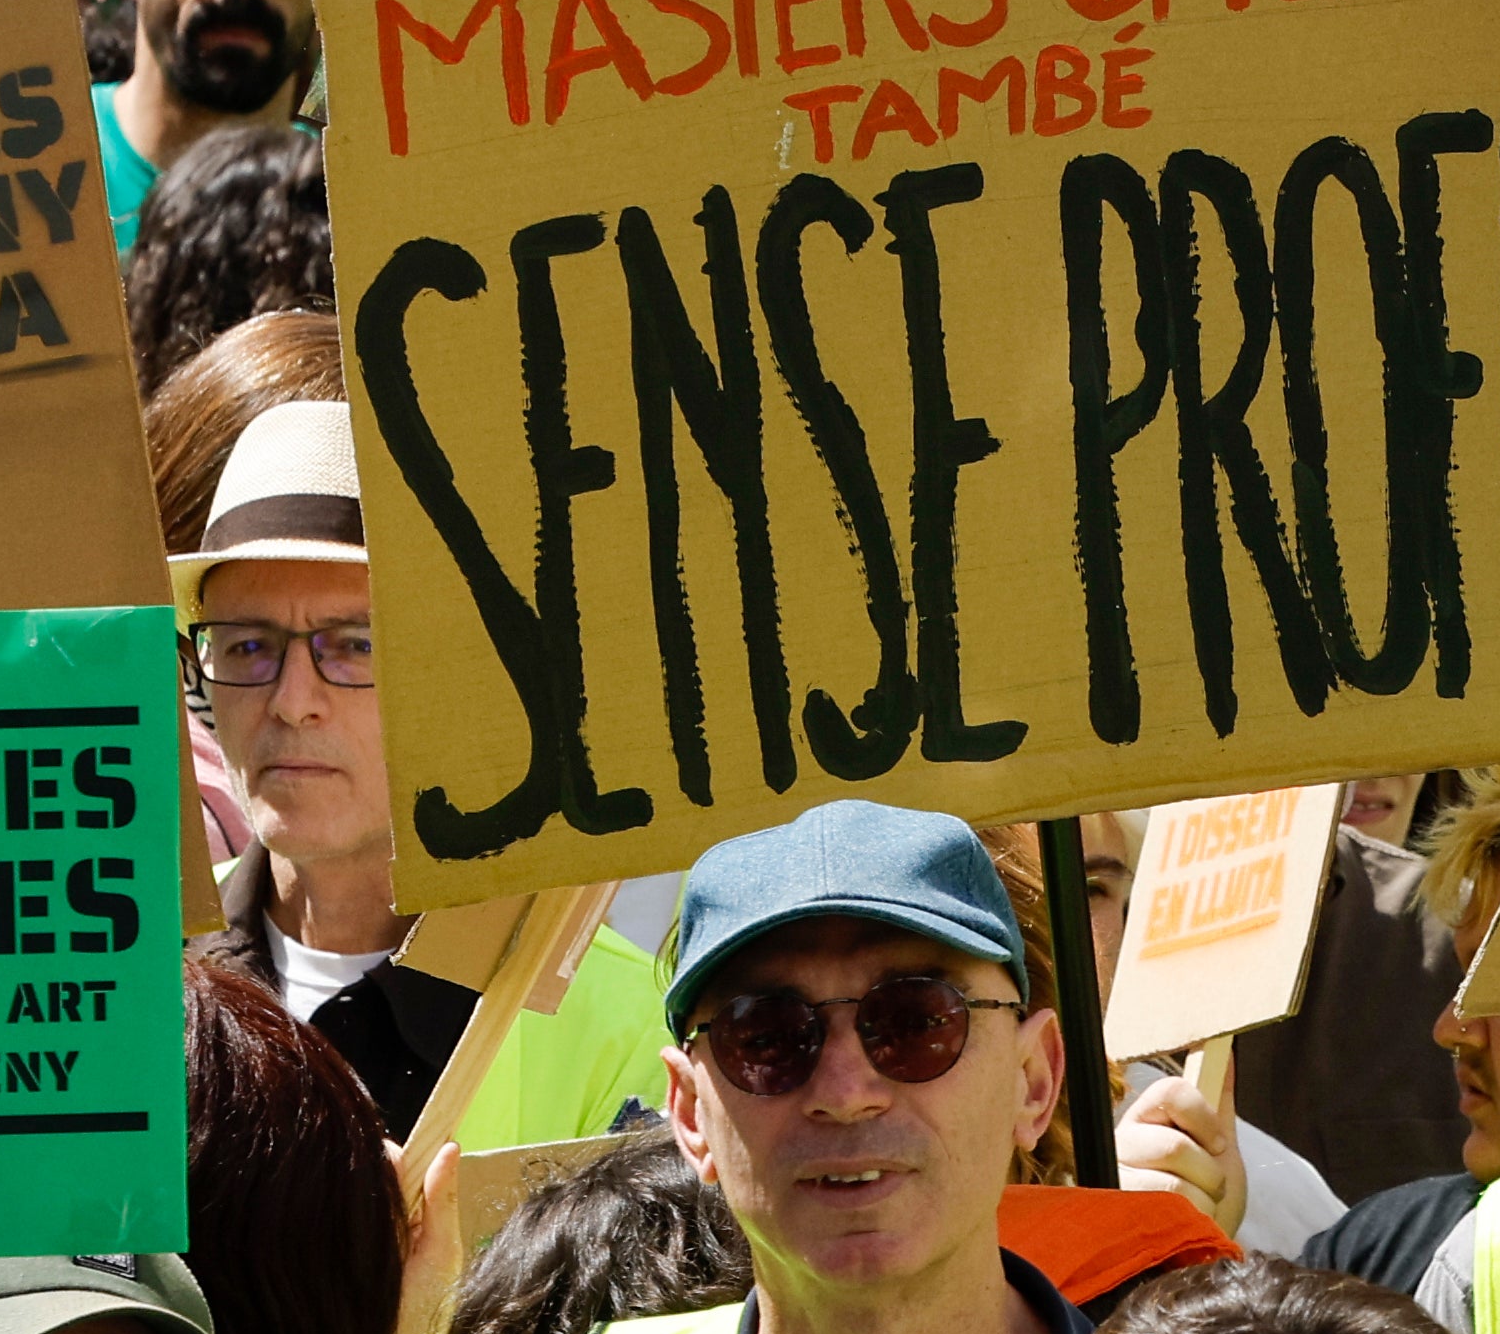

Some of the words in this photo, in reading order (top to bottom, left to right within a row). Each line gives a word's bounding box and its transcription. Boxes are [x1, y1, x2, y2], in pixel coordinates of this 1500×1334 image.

[782, 22, 1154, 164] TAMBÉ
[353, 159, 1030, 861] SENSE
[1159, 818, 1178, 874] I
[1178, 786, 1302, 868] DISSENY
[1144, 880, 1191, 943] EN
[1188, 851, 1287, 929] LLUITA
